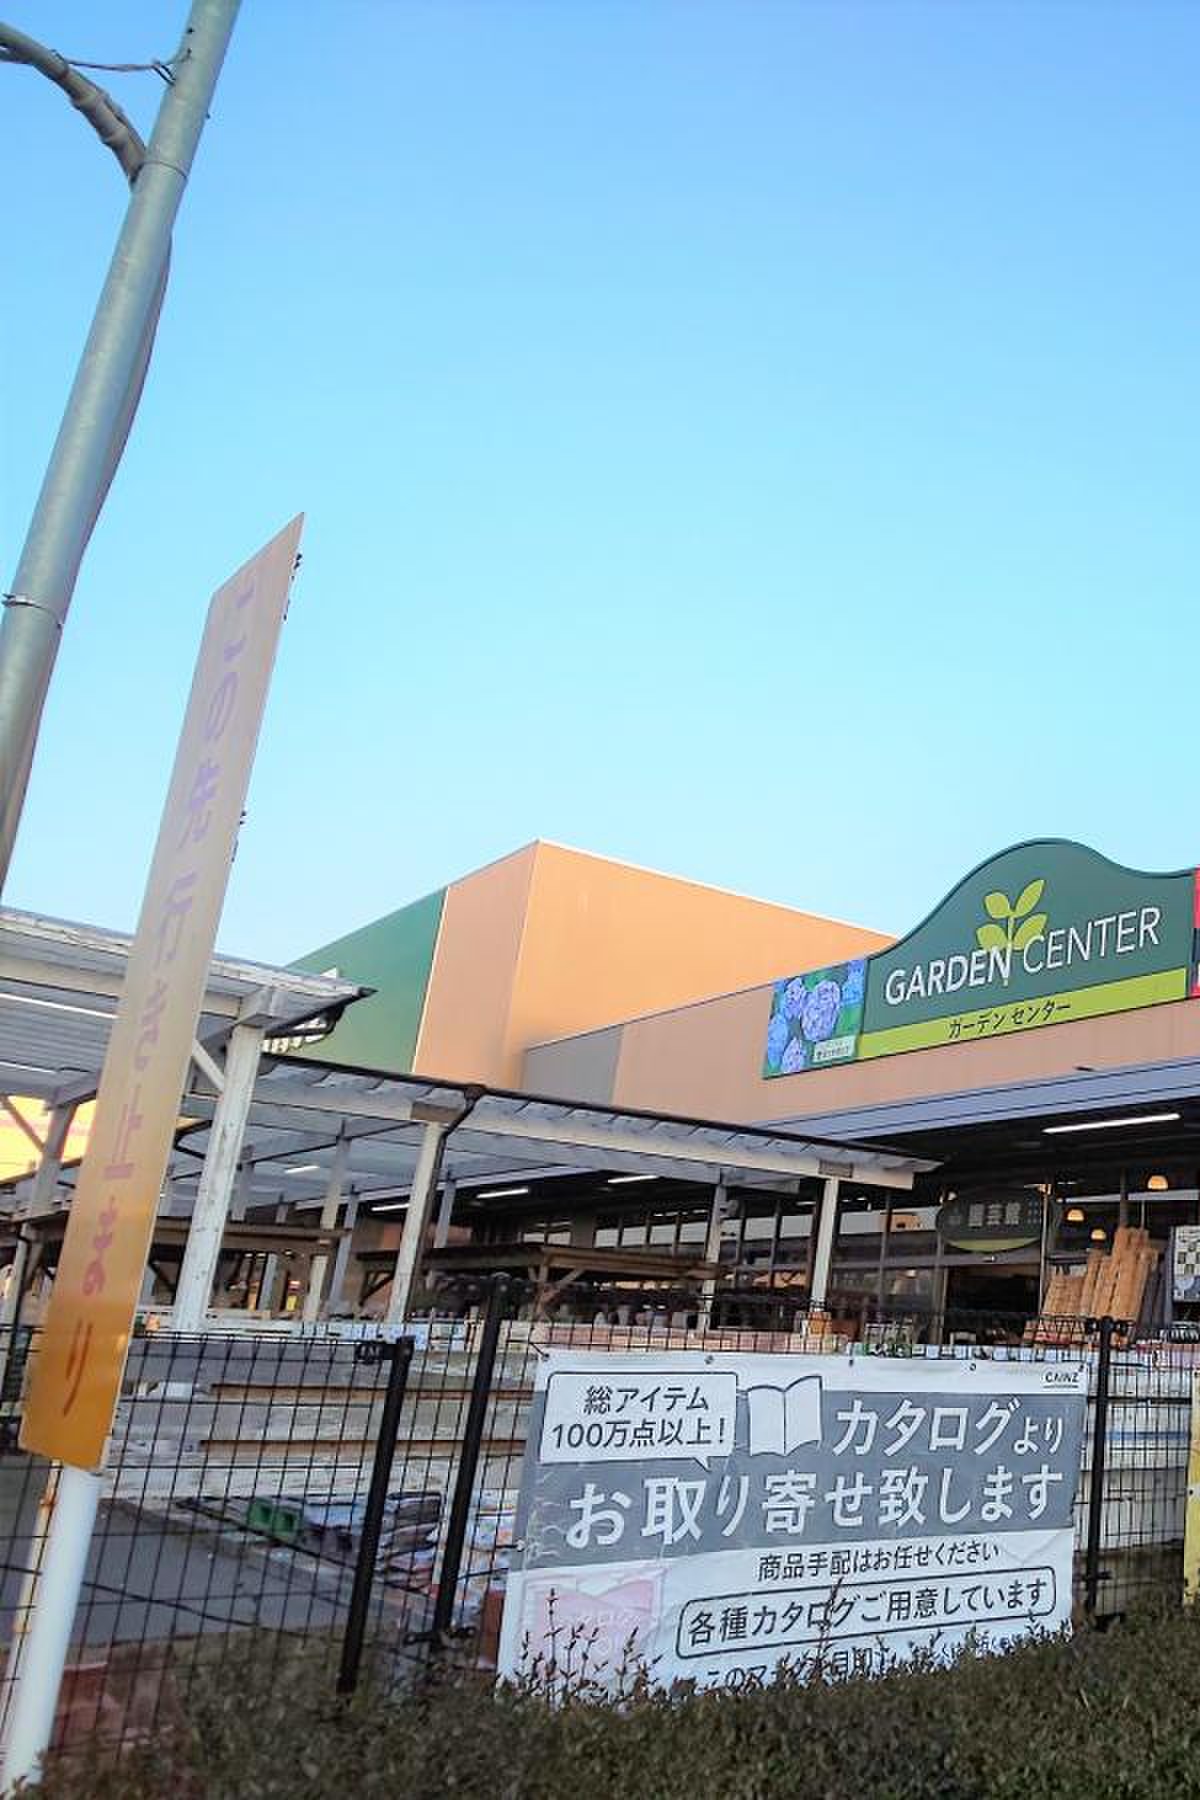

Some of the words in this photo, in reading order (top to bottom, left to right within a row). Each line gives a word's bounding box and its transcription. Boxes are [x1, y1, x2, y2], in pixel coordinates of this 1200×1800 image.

[885, 943, 1011, 1004] GARDEN
[1023, 907, 1161, 974] CENTER
[949, 1012, 1006, 1038] ガーデン
[1011, 1000, 1071, 1026] センター
[584, 1385, 709, 1415] 総アイテム
[551, 1416, 727, 1450] 100万点以上!
[835, 1397, 1065, 1458] カタログより
[565, 1464, 1064, 1549] お取り寄せ致します
[757, 1541, 1000, 1582] 商品手配はお任せください
[687, 1578, 1048, 1648] 各種カタログご用意しています
